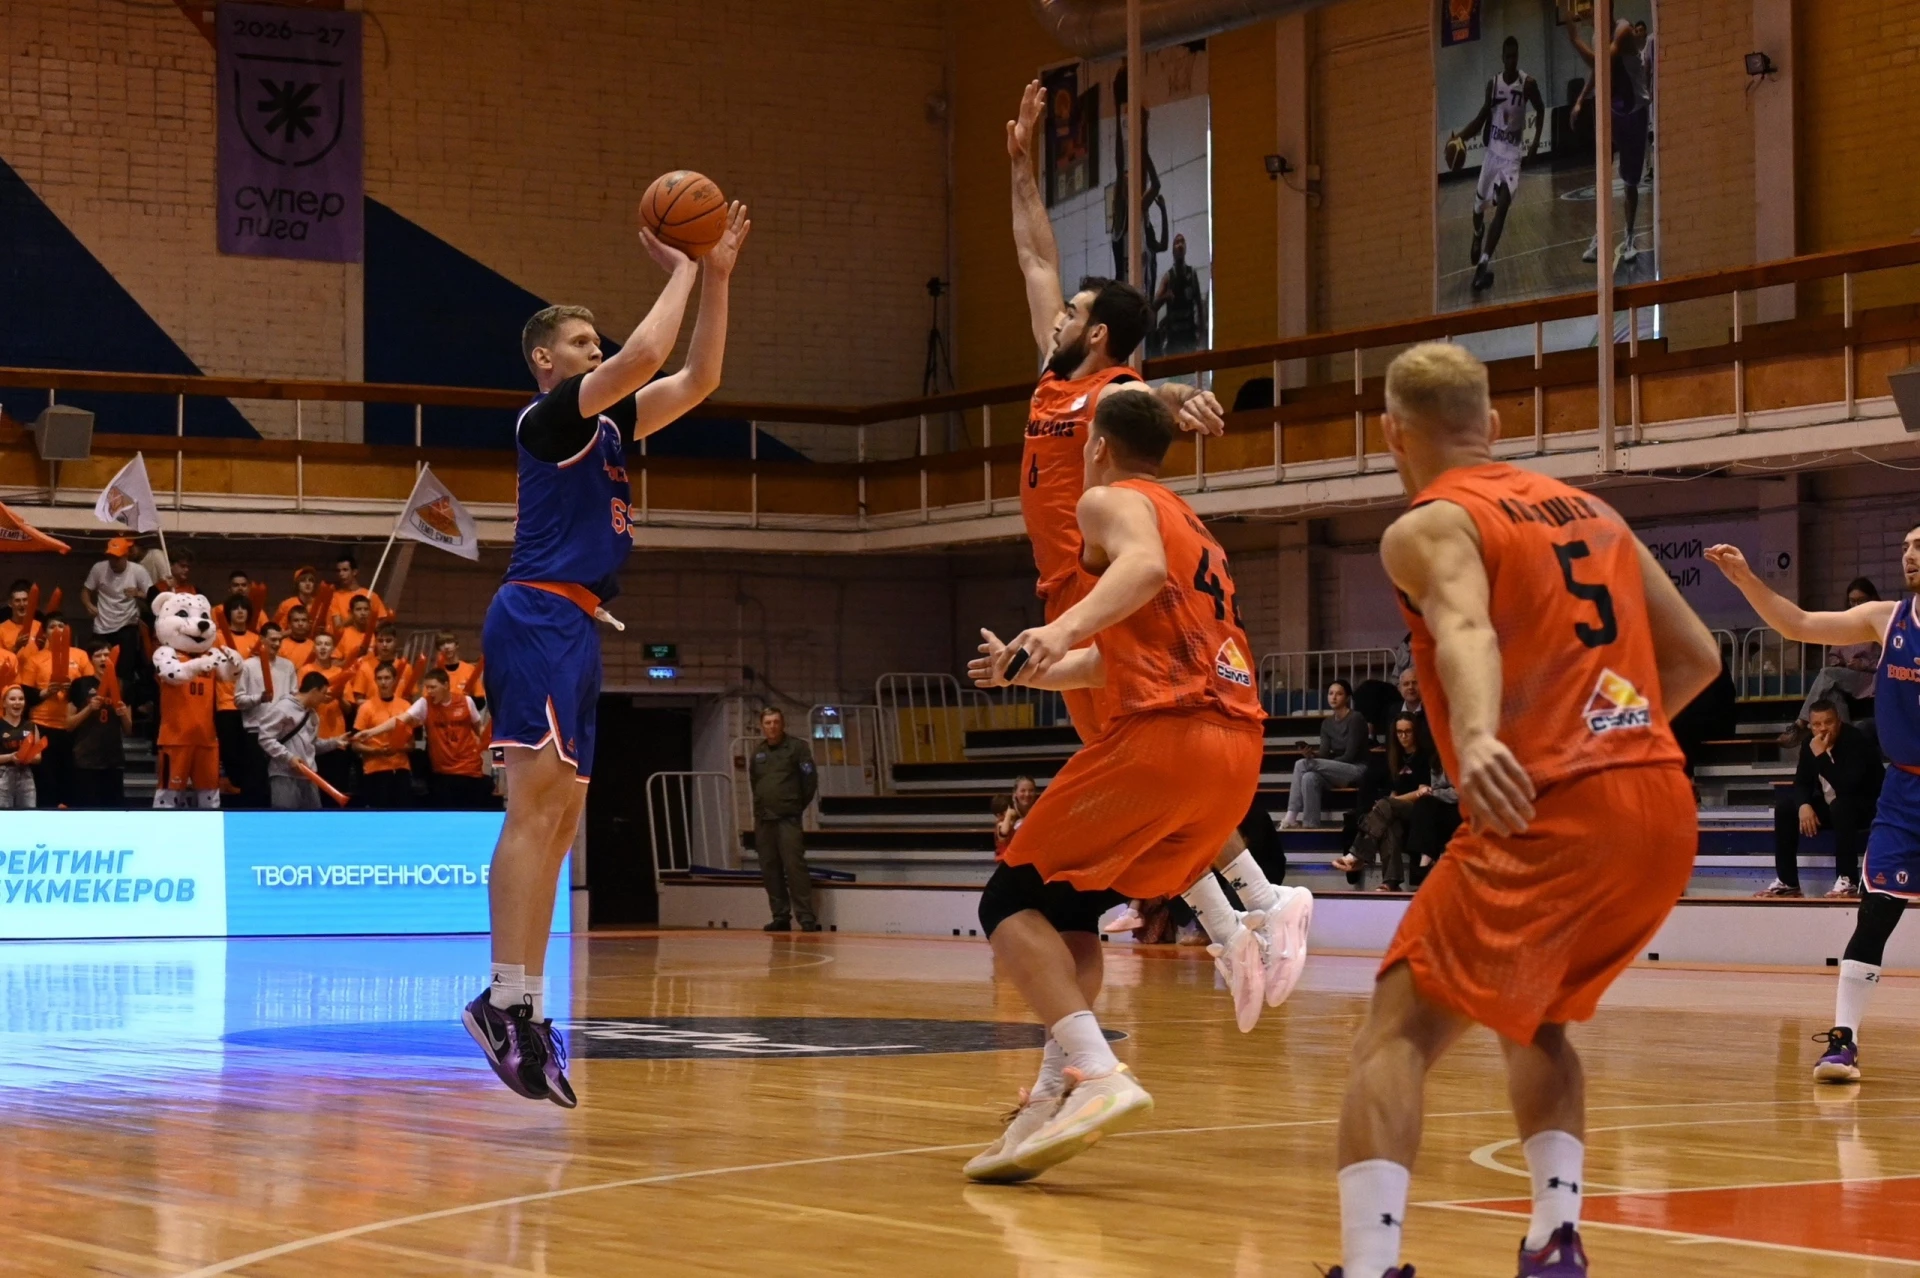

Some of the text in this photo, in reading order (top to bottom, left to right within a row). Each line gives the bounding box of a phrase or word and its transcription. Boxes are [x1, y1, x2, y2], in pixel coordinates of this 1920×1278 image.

[235, 186, 345, 223] супер
[1028, 453, 1039, 489] 6
[1551, 540, 1618, 649] 5
[0, 878, 195, 904] УКМЕКЕРОВ
[251, 865, 312, 886] ТВОЯ
[317, 864, 477, 886] УВЕРЕННОСТЬ
